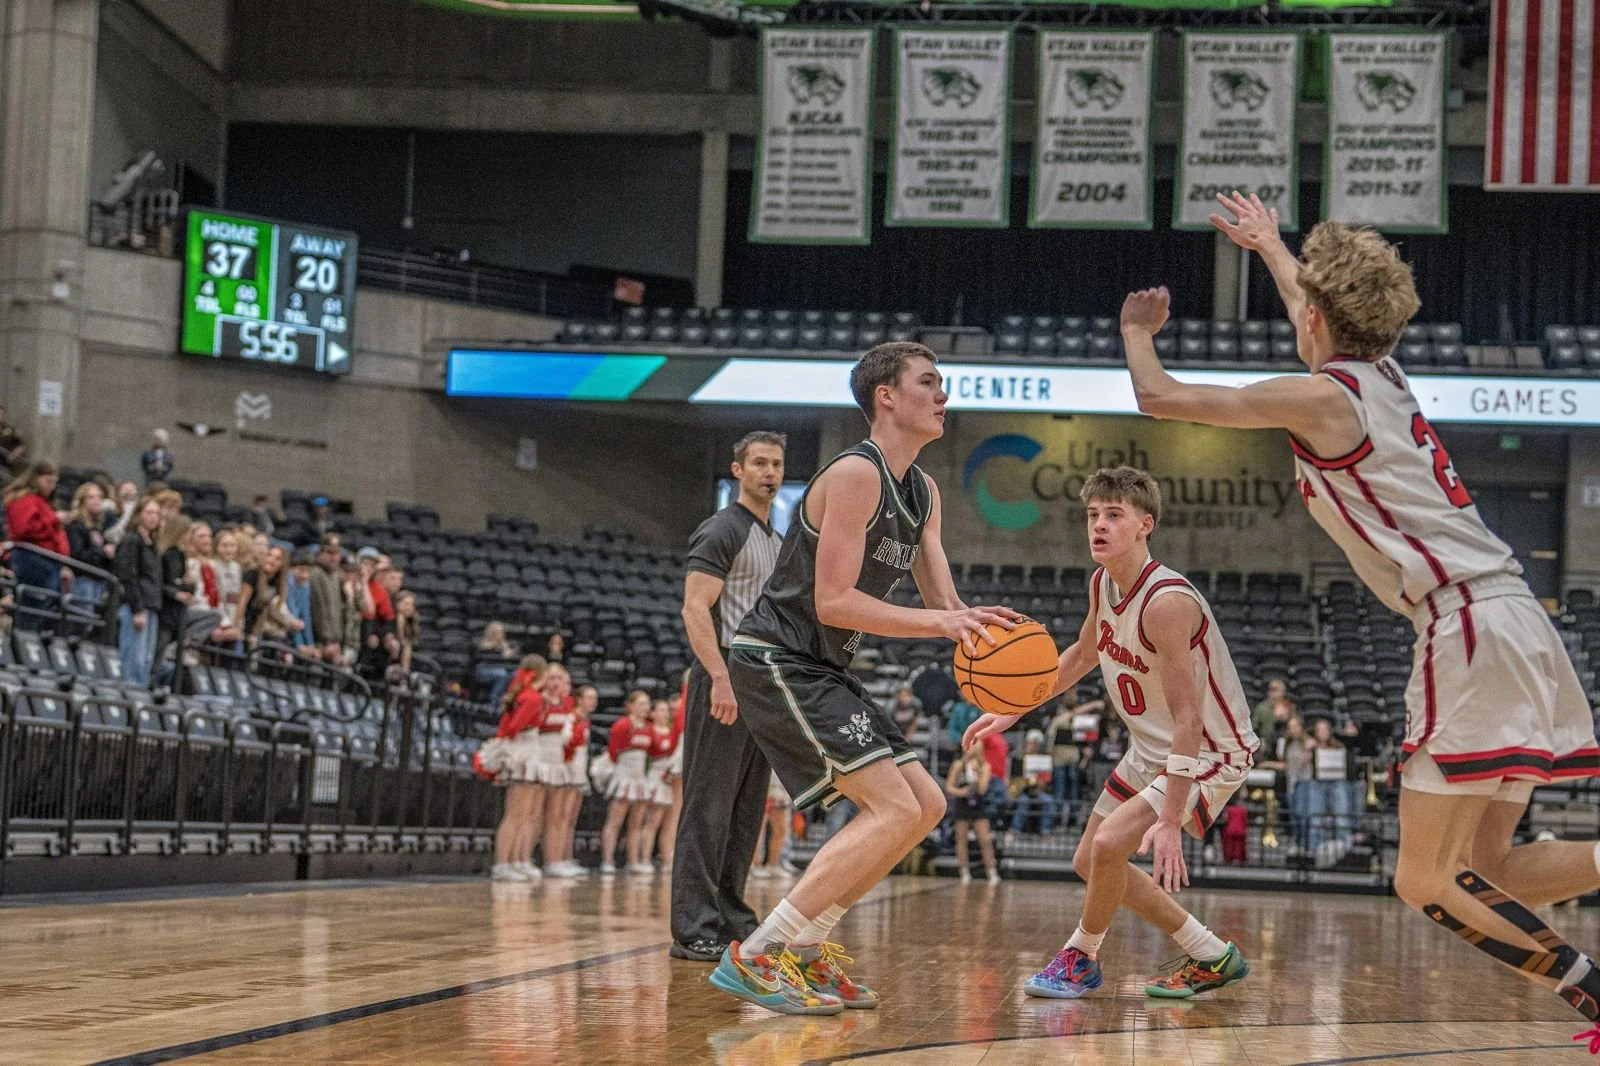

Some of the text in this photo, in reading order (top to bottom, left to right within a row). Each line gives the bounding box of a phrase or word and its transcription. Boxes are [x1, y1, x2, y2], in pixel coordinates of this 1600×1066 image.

[813, 37, 866, 49] VALLEY
[947, 40, 1001, 51] VALLEY
[1091, 41, 1146, 52] VALLEY
[1235, 42, 1290, 53] VALLEY
[1381, 43, 1437, 54] VALLEY
[1334, 137, 1437, 151] CHAMPIONS
[1043, 151, 1142, 165] CHAMPIONS
[1187, 152, 1287, 166] CHAMPIONS
[1056, 182, 1128, 203] 2004
[201, 219, 259, 246] HOME
[290, 234, 347, 260] AWAY
[207, 242, 252, 279] 37
[295, 255, 338, 294] 20
[959, 376, 1052, 401] CENTER
[1471, 387, 1578, 416] GAMES
[1068, 438, 1149, 471] Utah
[1032, 462, 1297, 519] Counity
[1097, 620, 1150, 674] Rams
[1117, 673, 1147, 716] 0
